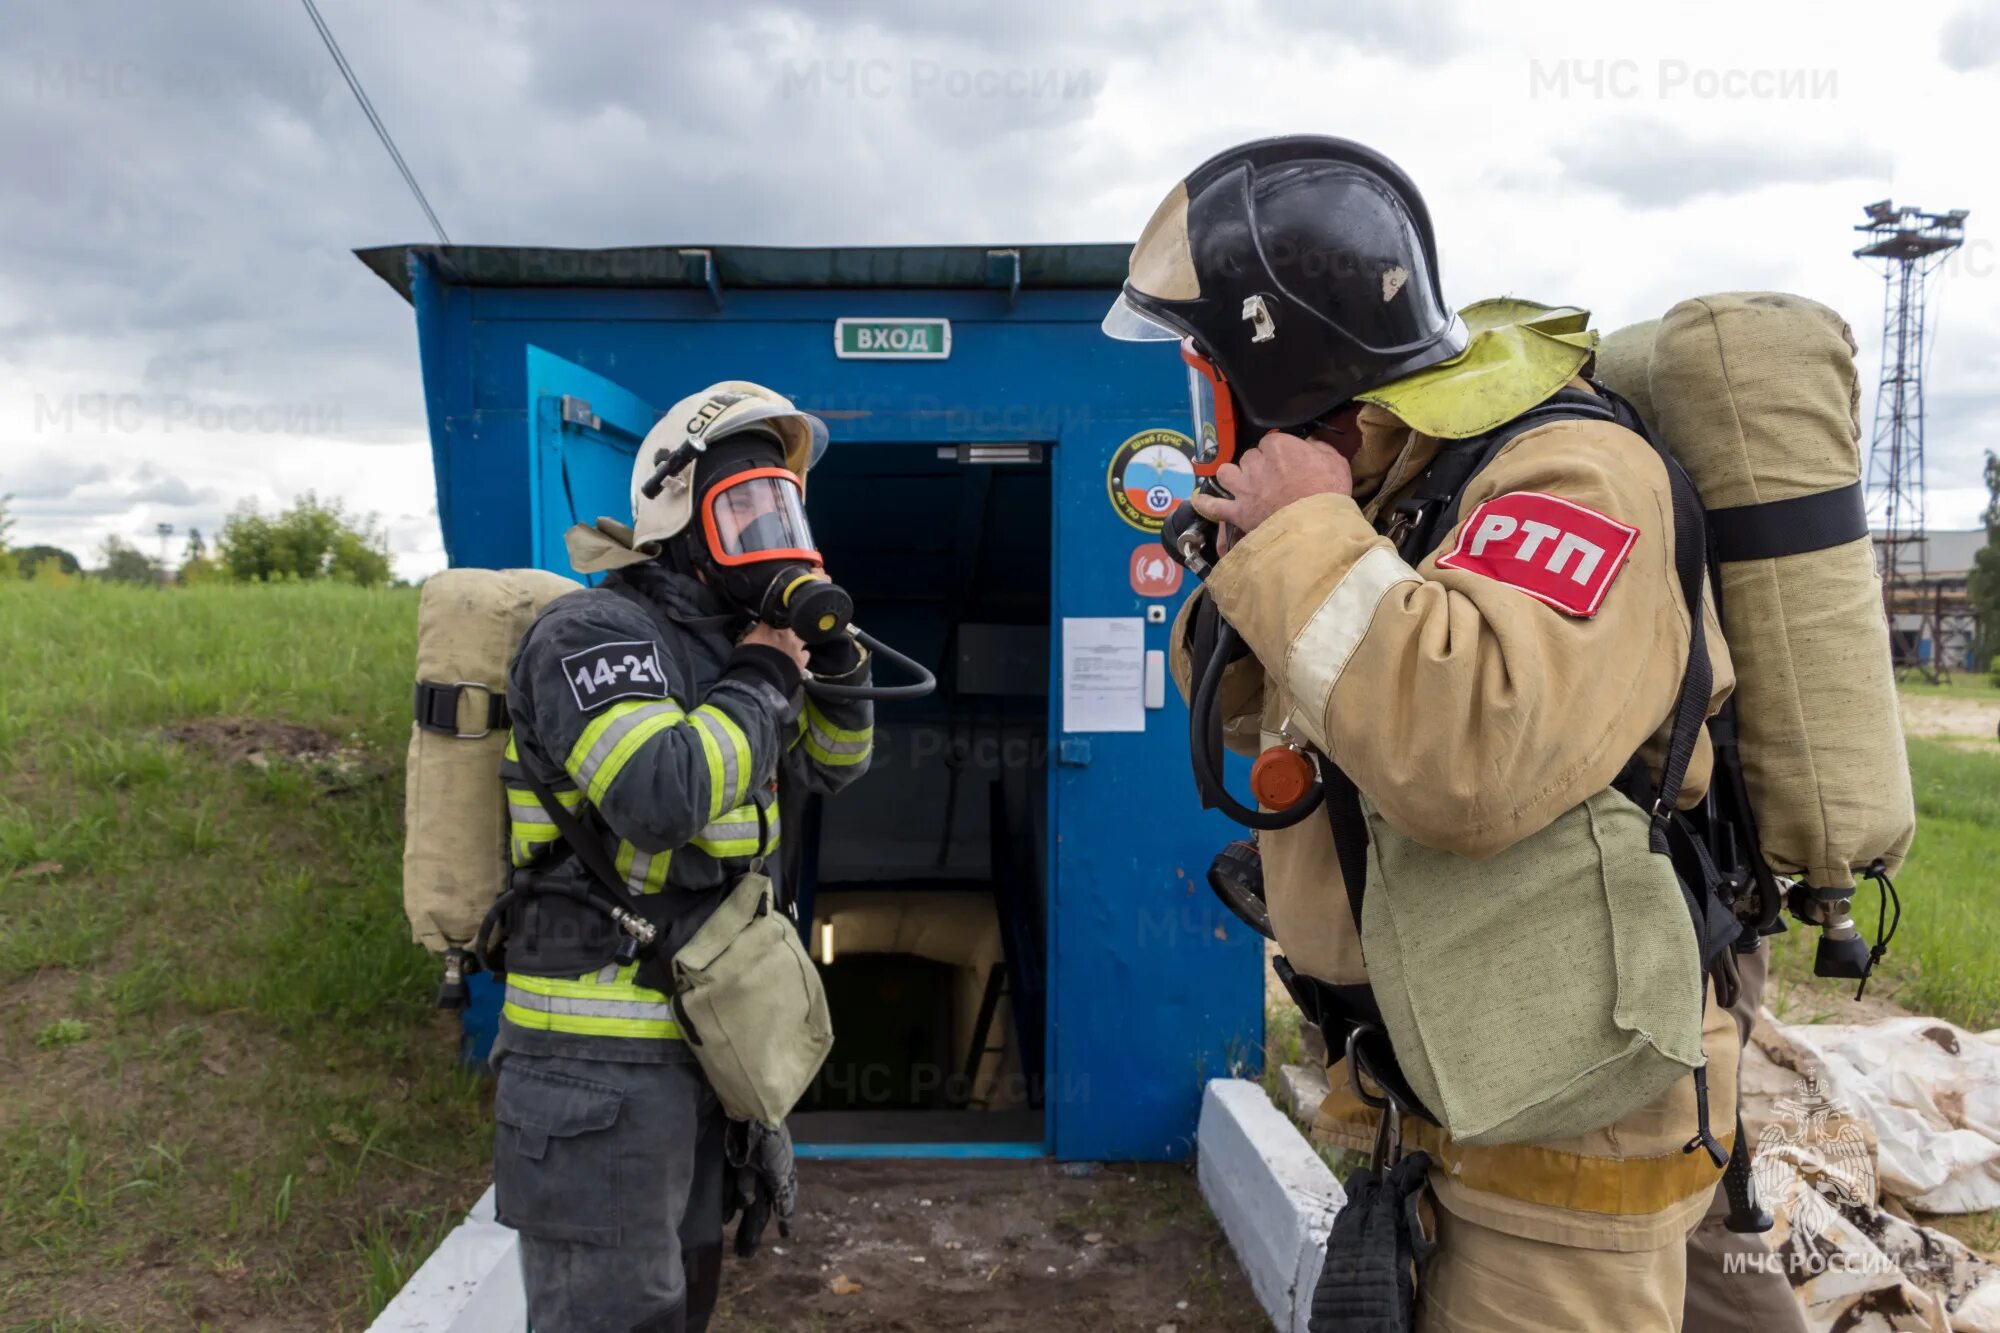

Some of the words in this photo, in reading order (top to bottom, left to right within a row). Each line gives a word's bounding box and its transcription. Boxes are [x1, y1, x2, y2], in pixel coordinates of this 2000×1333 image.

[857, 328, 928, 352] ВХОД
[1132, 434, 1156, 450] Штаб
[1156, 434, 1182, 446] ГОЧС
[1469, 514, 1606, 586] РТП
[575, 655, 663, 694] 14-21
